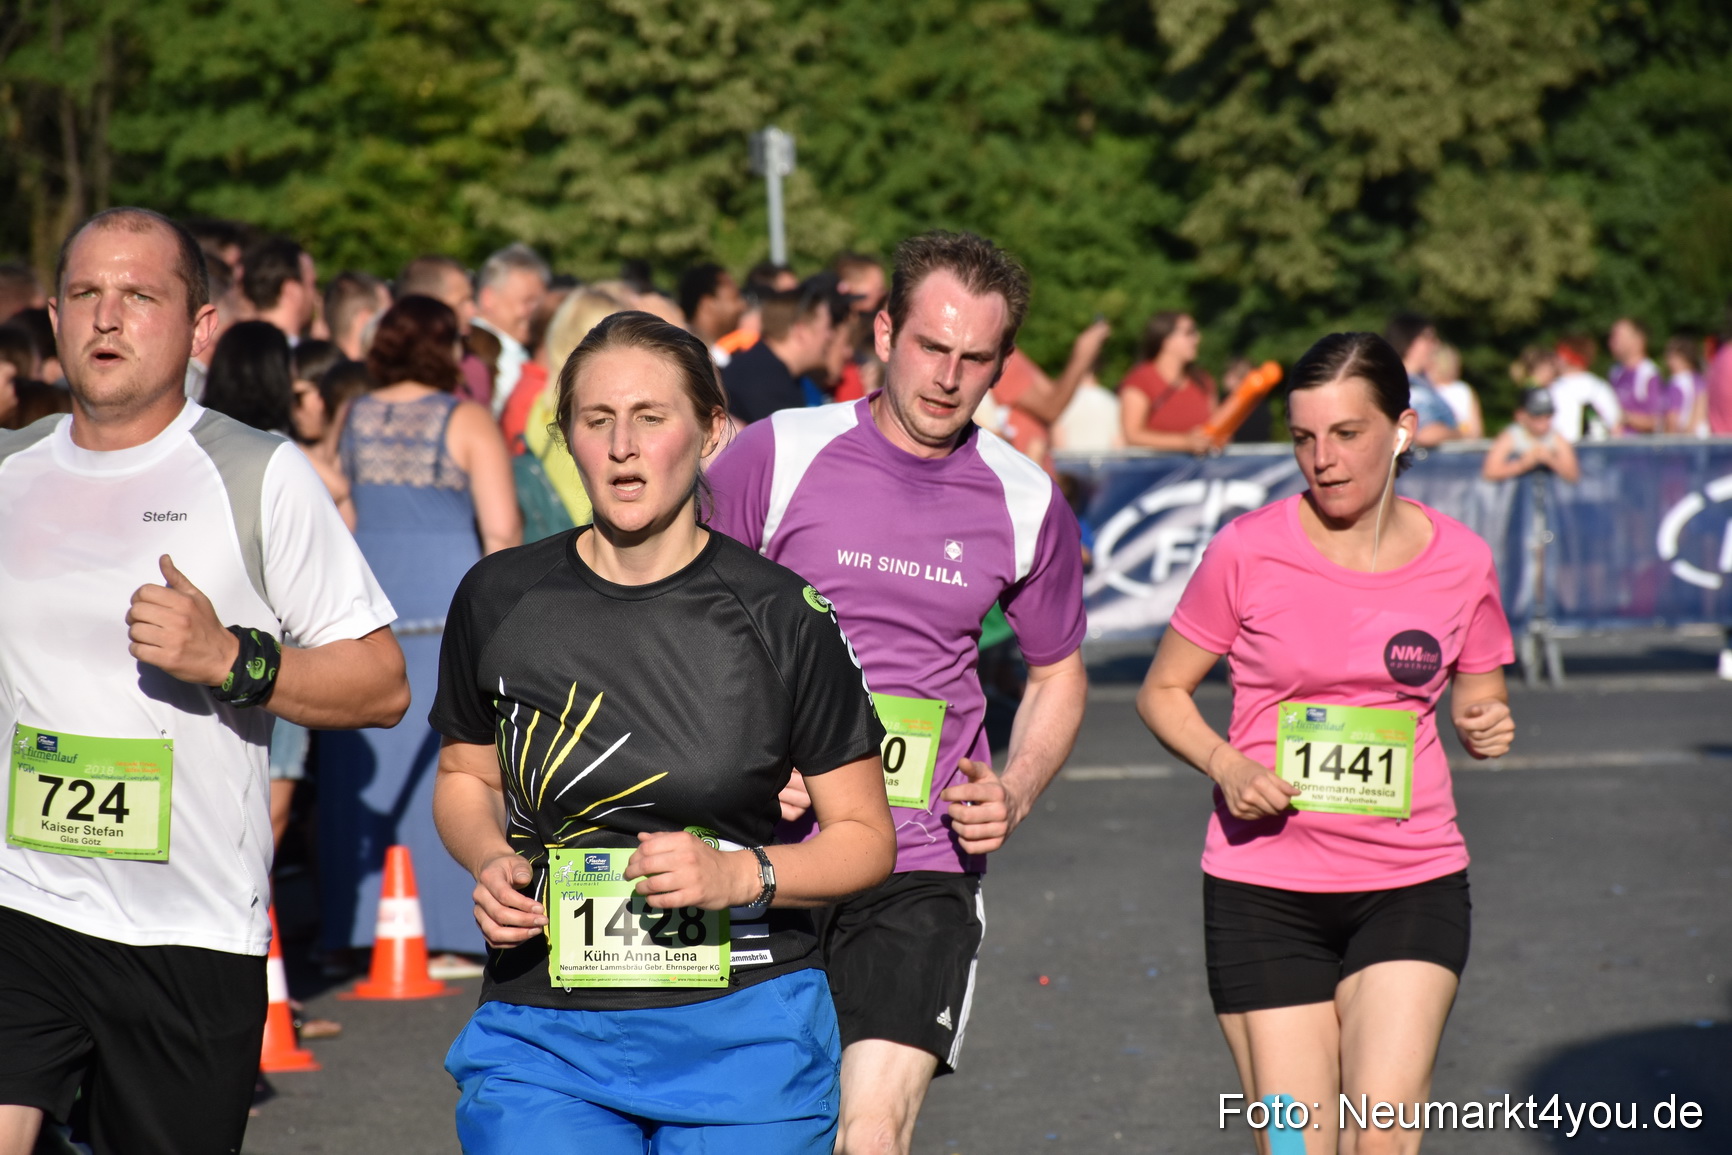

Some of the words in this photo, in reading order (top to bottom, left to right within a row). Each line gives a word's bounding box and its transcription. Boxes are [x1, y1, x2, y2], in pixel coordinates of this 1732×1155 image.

[142, 510, 188, 522] Stefan
[837, 549, 872, 569] WIR
[877, 556, 920, 577] SIND
[924, 564, 968, 588] LILA.
[27, 745, 79, 764] firmenlauf
[883, 736, 907, 774] 0
[84, 764, 115, 776] 2018
[1295, 742, 1393, 785] 1441
[885, 776, 899, 786] ias
[1293, 781, 1356, 795] Bornemann
[1359, 786, 1396, 798] Jessica
[38, 774, 130, 823] 724
[1344, 797, 1377, 805] Apotheke
[41, 819, 80, 834] Kaiser
[83, 825, 124, 837] Stefan
[60, 835, 79, 844] Glas
[81, 837, 101, 846] Götz
[573, 869, 626, 882] firmenla
[573, 898, 707, 947] 1428
[584, 950, 620, 962] Kühn
[624, 950, 661, 962] Anna
[665, 950, 697, 962] Lena
[730, 953, 768, 962] ammsbräu
[666, 964, 708, 972] Ehrnsperger
